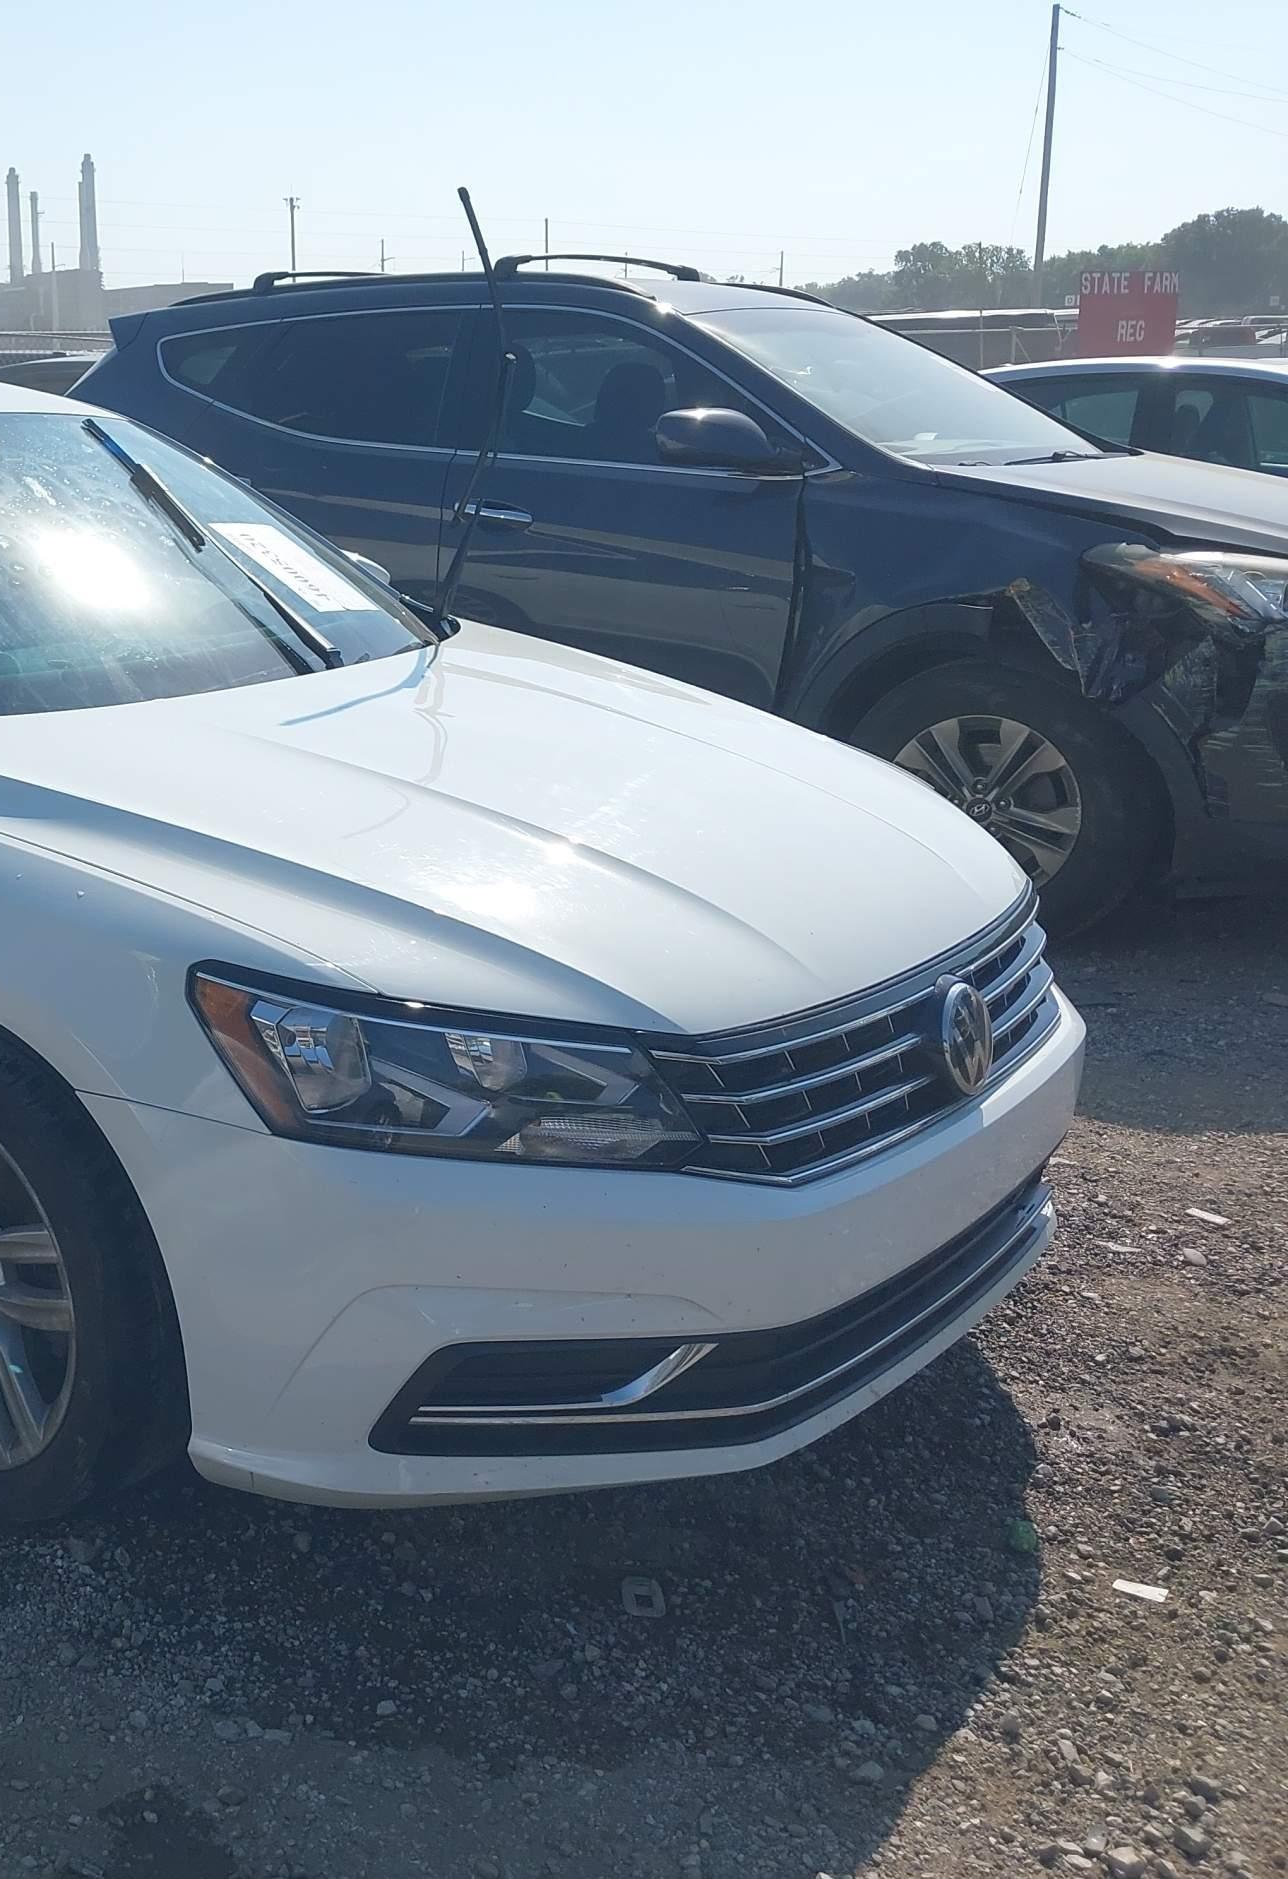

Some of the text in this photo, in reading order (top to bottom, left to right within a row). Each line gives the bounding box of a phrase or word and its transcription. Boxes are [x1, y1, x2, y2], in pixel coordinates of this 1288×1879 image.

[1081, 271, 1180, 295] STATE FARM
[1117, 319, 1145, 343] REG
